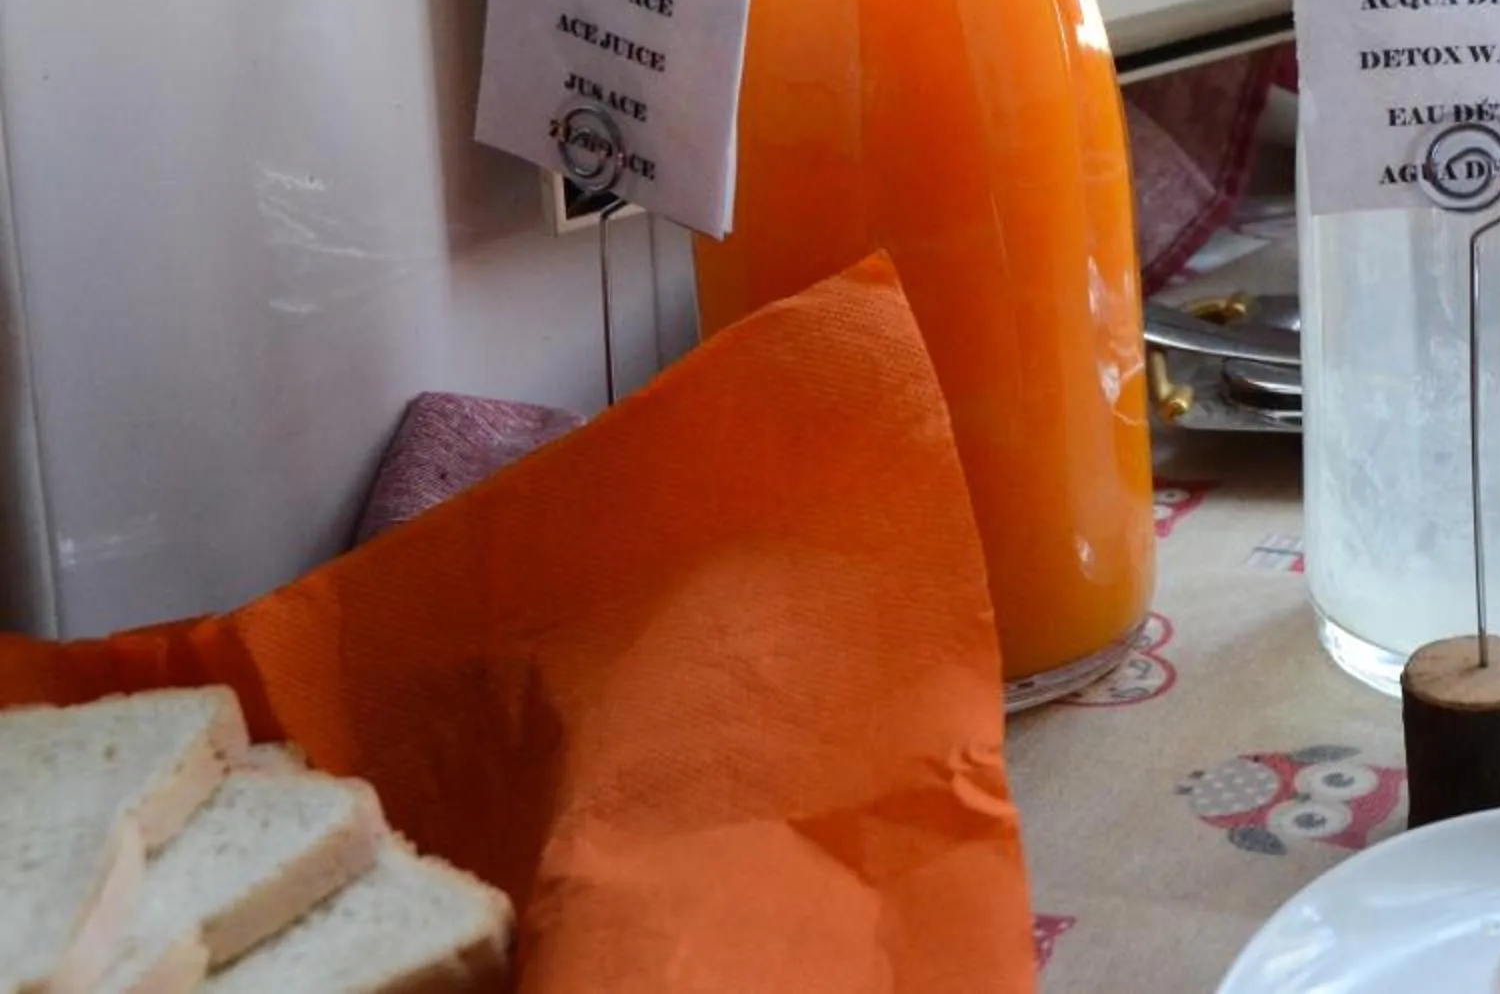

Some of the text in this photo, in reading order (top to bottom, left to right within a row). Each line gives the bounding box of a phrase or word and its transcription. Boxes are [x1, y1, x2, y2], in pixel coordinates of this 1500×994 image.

[555, 13, 666, 73] ACE JUICE
[1360, 45, 1462, 70] DETOX
[564, 73, 647, 122] JUS ACE
[1388, 105, 1444, 127] EAU
